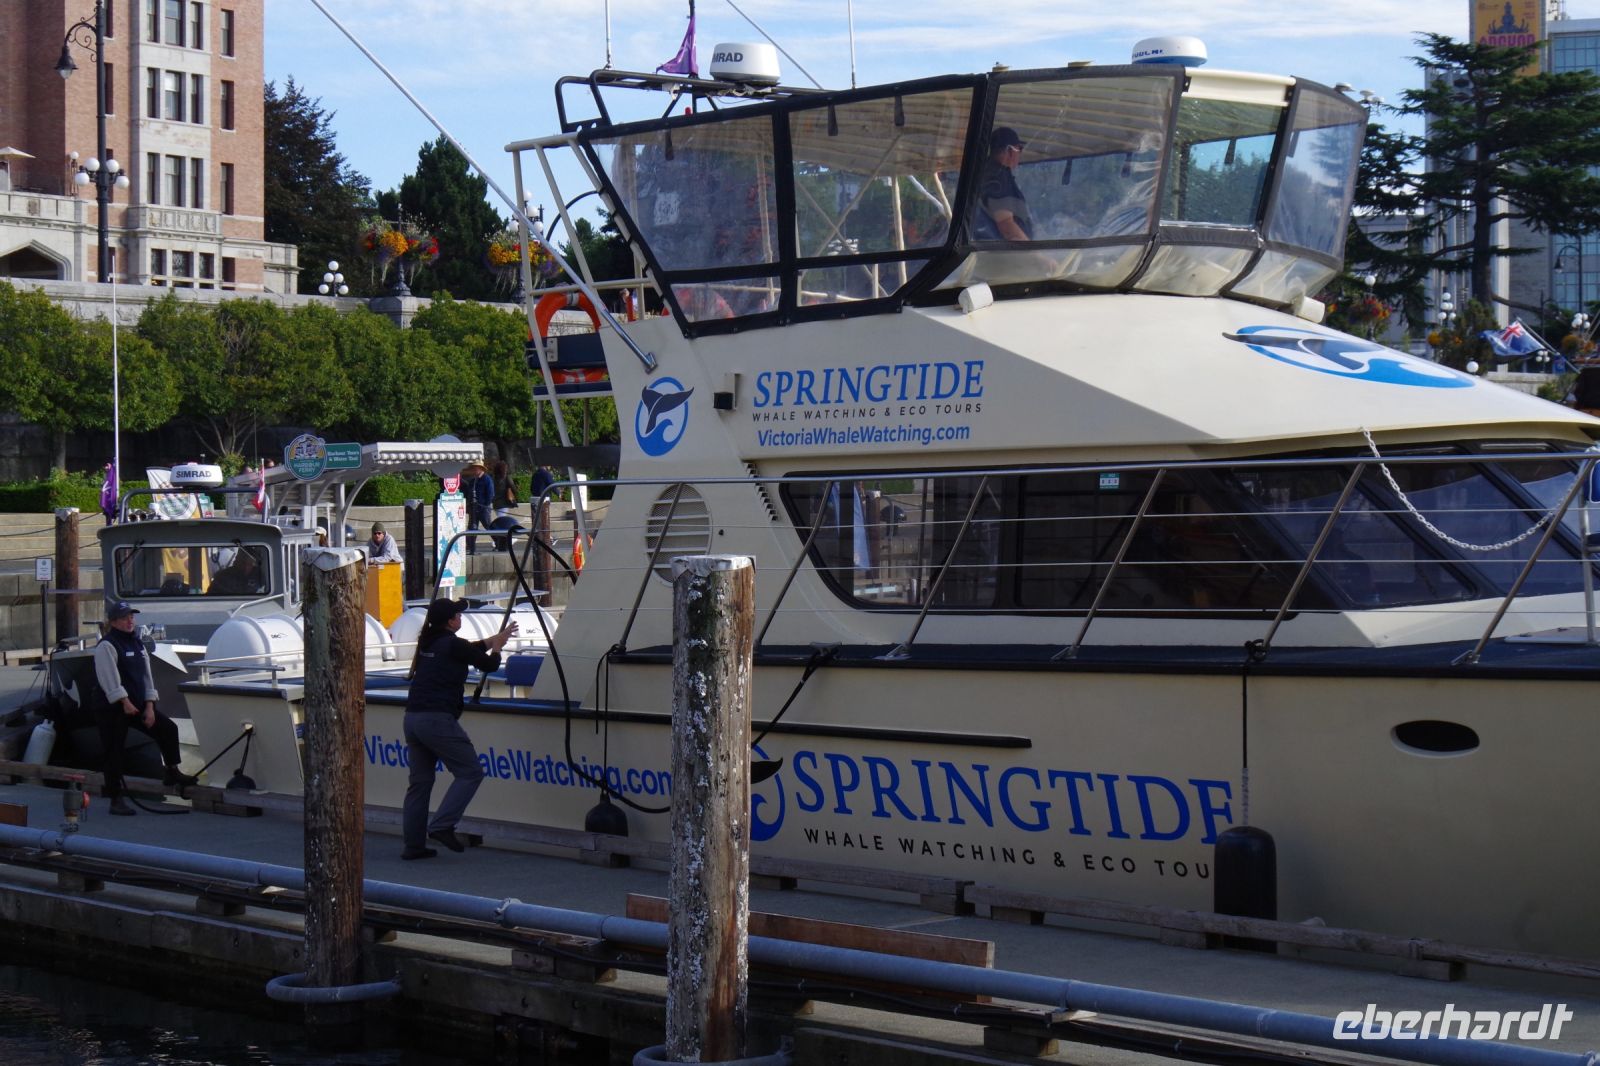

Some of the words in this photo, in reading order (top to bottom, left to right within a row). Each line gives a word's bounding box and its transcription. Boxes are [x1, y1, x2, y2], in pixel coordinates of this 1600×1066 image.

[753, 360, 984, 408] SPRINGTIDE
[752, 411, 796, 422] WHALE
[804, 407, 876, 420] WATCHING
[884, 407, 891, 417] &
[900, 405, 926, 416] ECO
[936, 403, 982, 415] TOURS
[758, 423, 970, 447] VictoriaWhaleWatching.com
[176, 470, 212, 478] SIMRAD
[792, 750, 1233, 845] SPRINGTIDE
[804, 828, 884, 851] WHALE
[898, 837, 1035, 865] WATCHING
[1053, 851, 1066, 868] &
[1083, 854, 1136, 873] ECO
[1154, 860, 1210, 879] TOU
